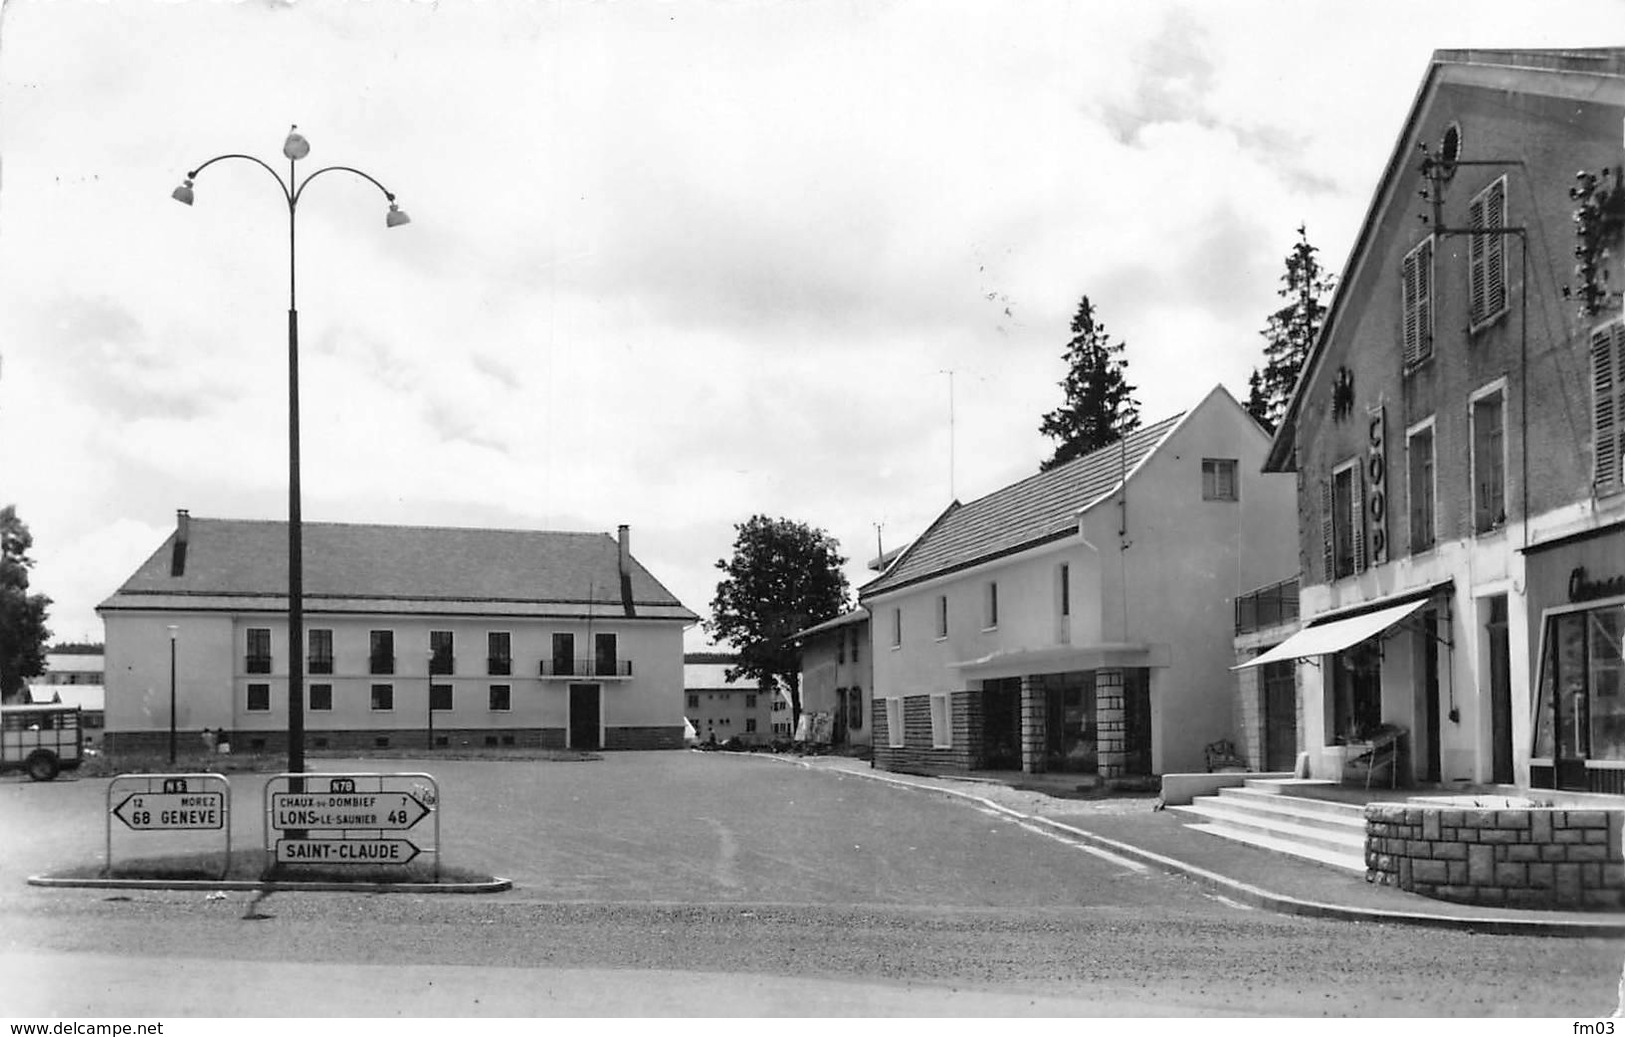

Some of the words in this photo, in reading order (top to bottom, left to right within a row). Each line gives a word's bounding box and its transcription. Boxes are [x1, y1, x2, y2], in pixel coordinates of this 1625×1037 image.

[1369, 417, 1385, 569] COOP
[332, 781, 353, 792] N78
[133, 798, 143, 808] 12
[181, 797, 216, 807] MOREZ
[280, 797, 313, 808] CHAUX
[329, 797, 376, 808] DOMBIEF
[401, 797, 408, 807] 7
[133, 811, 150, 824] 68
[161, 810, 216, 824] GENEVE
[388, 810, 407, 824] 48
[286, 844, 399, 859] SAINT-CLAUDE
